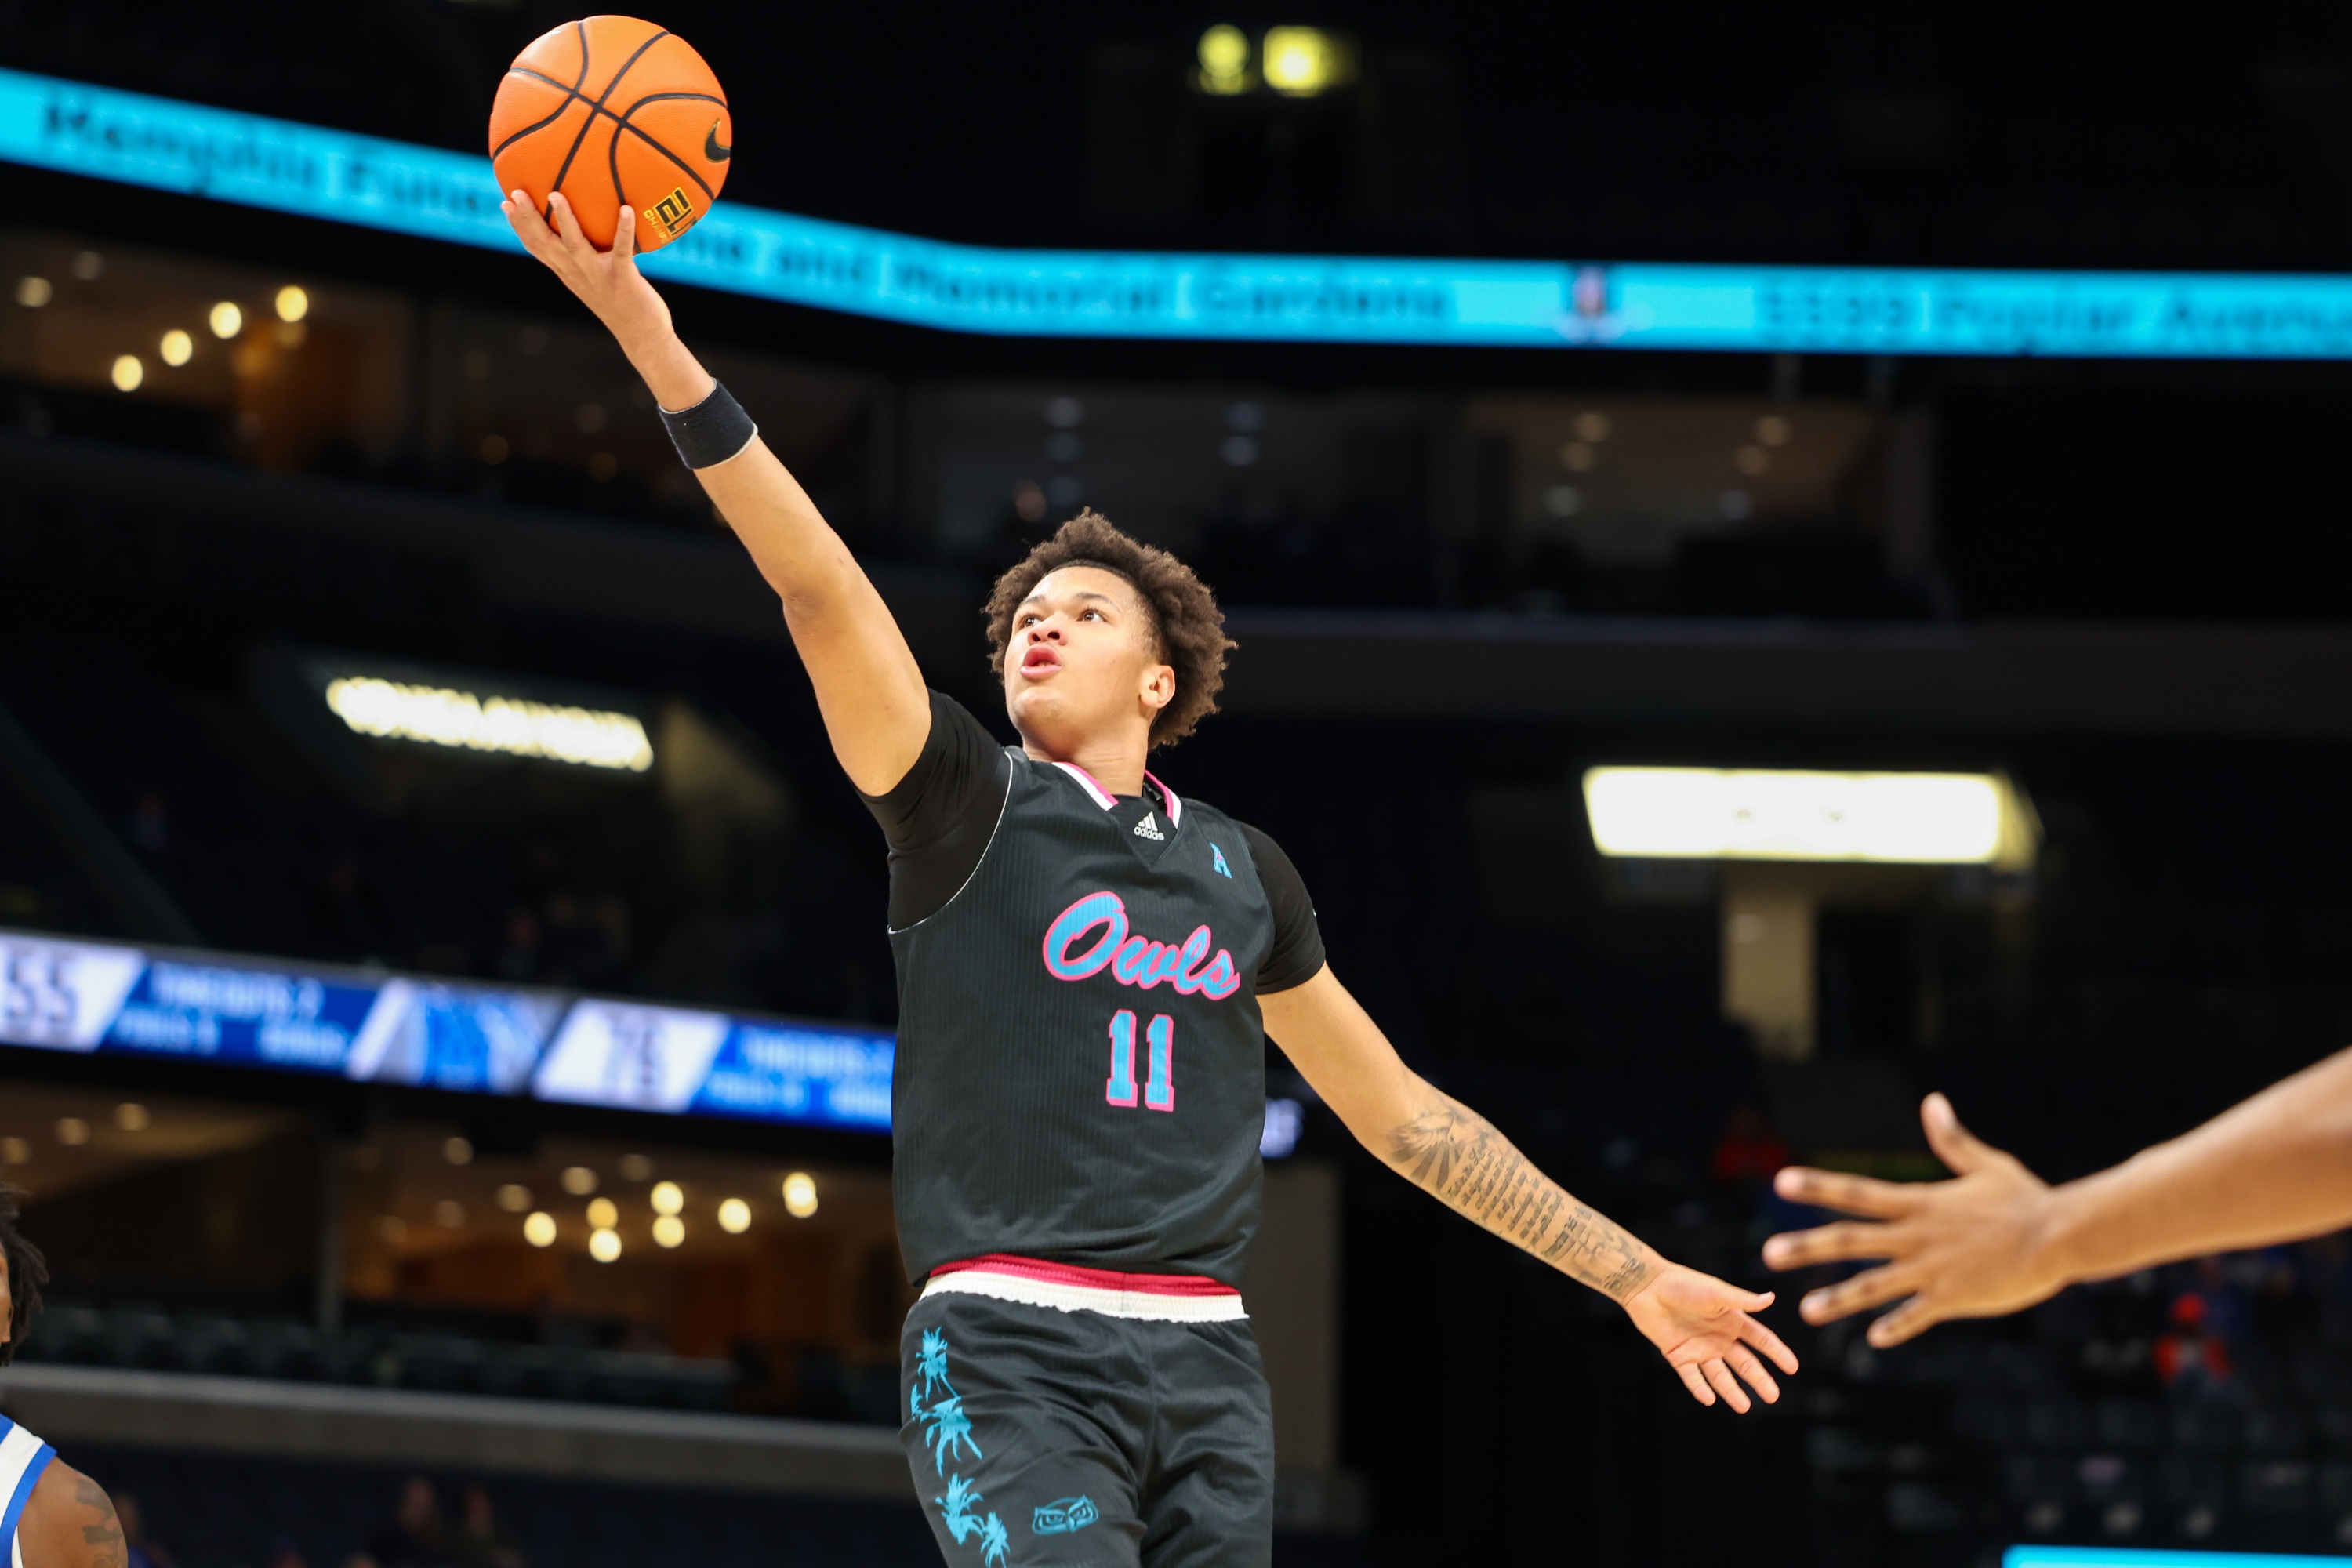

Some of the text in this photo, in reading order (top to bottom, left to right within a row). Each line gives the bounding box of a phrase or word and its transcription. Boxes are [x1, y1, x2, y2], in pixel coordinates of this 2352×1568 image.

[1134, 826, 1165, 841] adidas
[1042, 891, 1240, 1001] Owls
[1105, 1009, 1174, 1112] 11
